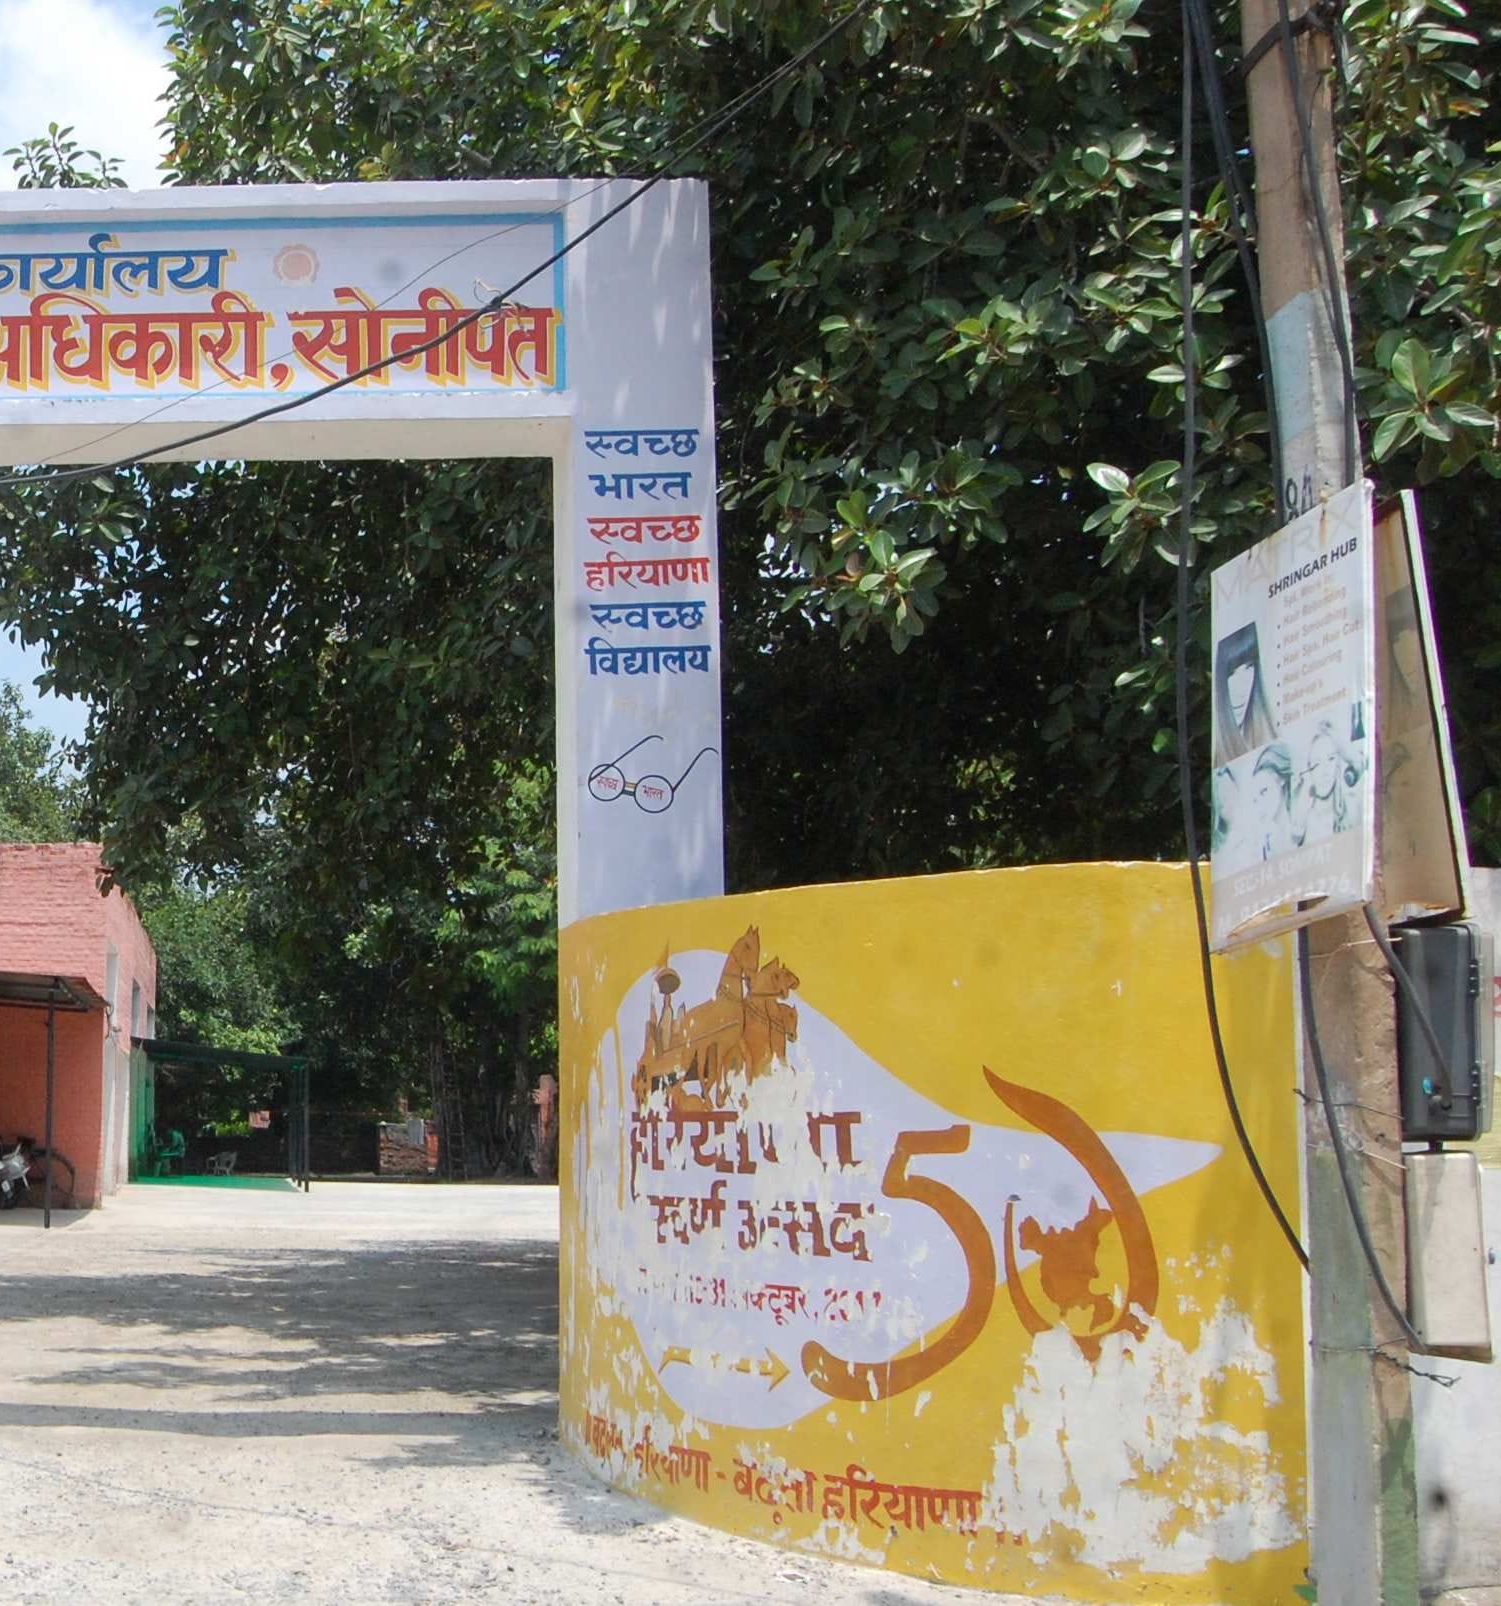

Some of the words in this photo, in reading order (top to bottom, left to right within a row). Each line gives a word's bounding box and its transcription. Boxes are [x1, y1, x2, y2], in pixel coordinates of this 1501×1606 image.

[291, 286, 557, 383] सोनीपत
[584, 428, 700, 459] स्वच्छ
[587, 471, 693, 501] भारत
[587, 514, 703, 545] स्वच्छ
[584, 551, 711, 592] हरियाणा
[1268, 553, 1328, 599] SHRINGAR
[1330, 537, 1358, 565] HUB
[588, 600, 707, 633] स्वच्छ
[584, 636, 712, 676] विद्यालय
[822, 1463, 984, 1538] हरियाणा
